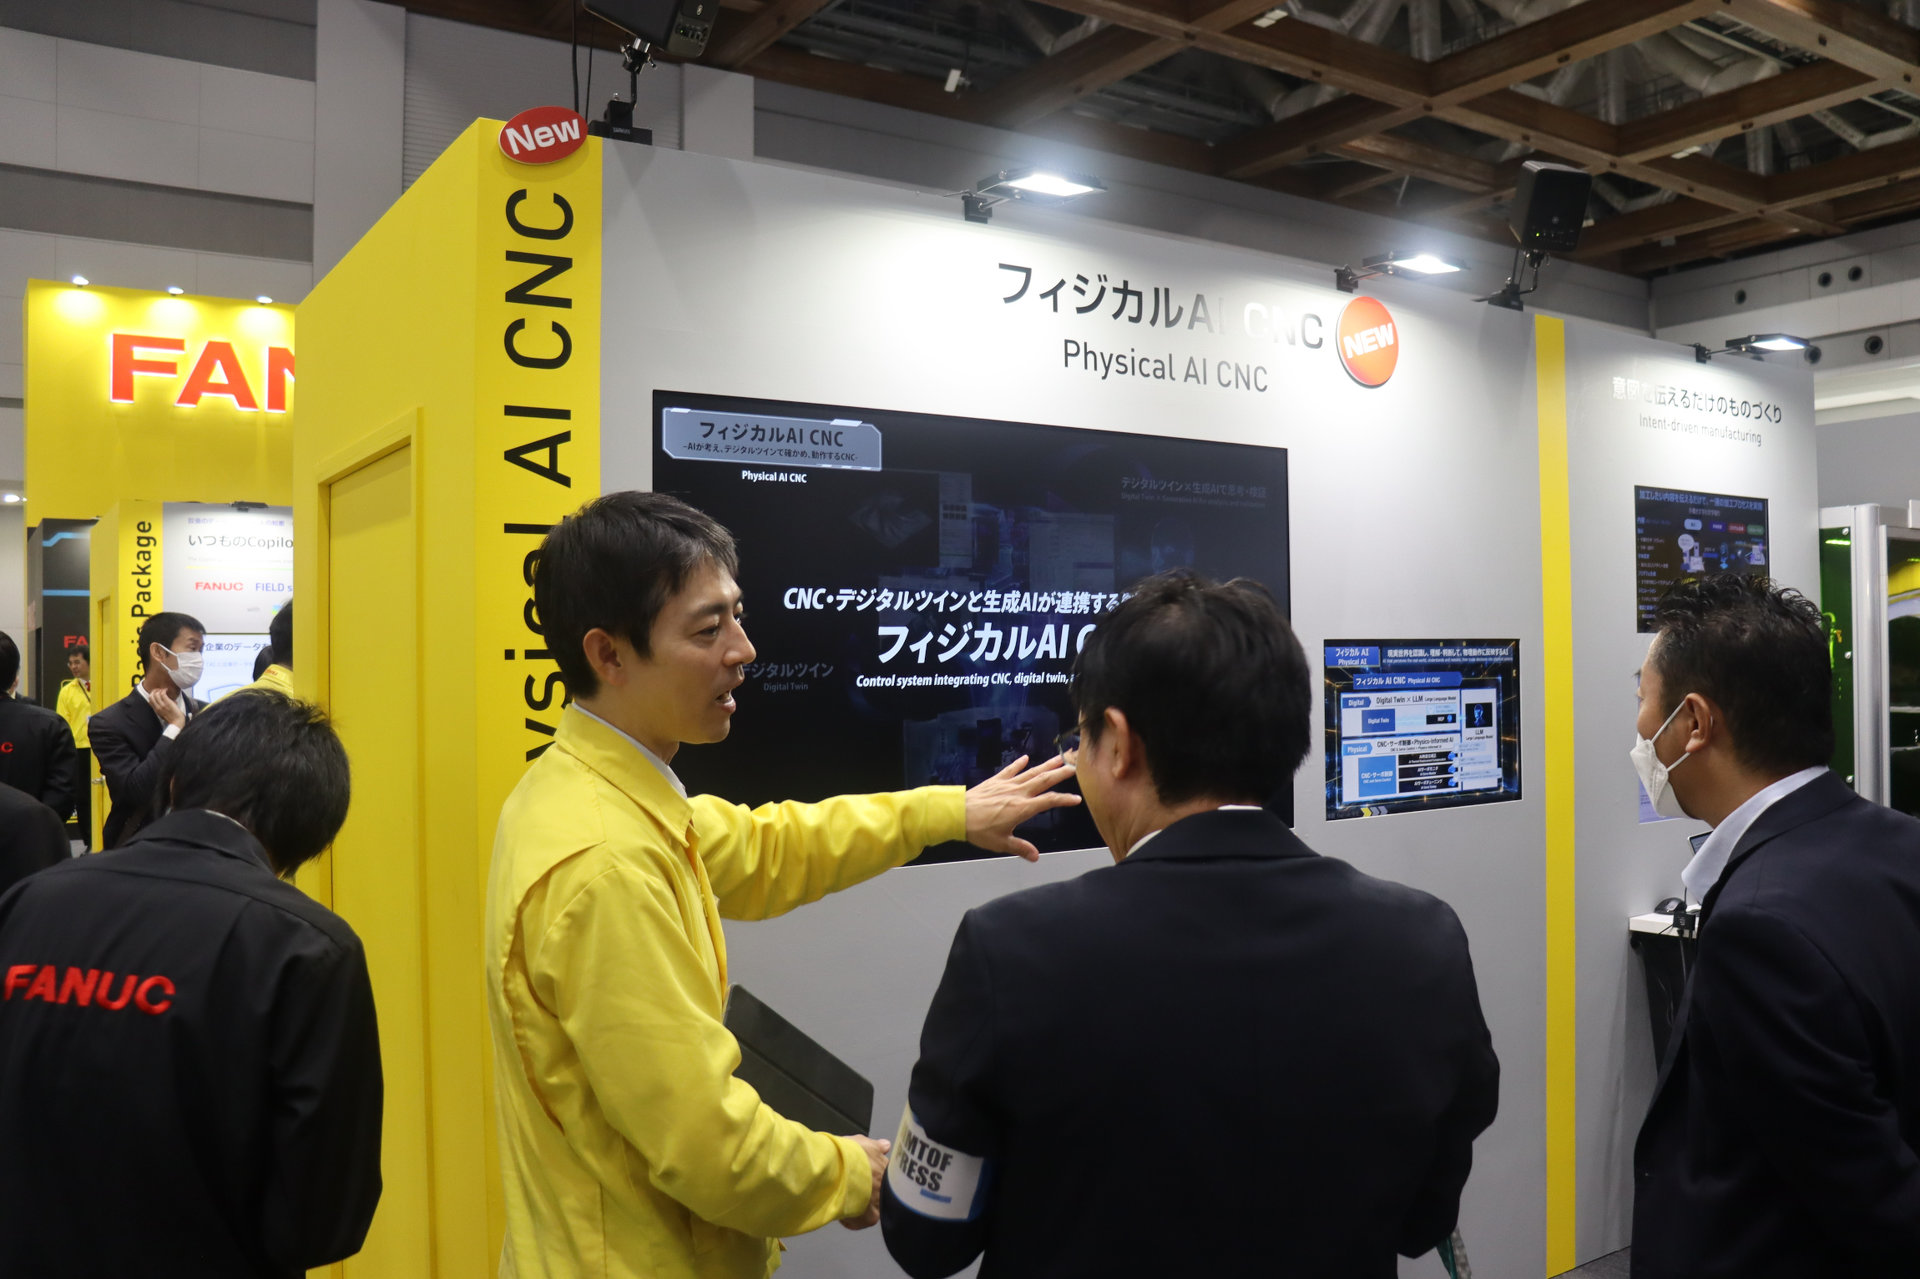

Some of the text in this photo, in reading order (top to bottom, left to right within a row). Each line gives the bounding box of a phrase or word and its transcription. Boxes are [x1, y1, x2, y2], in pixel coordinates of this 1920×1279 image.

[505, 118, 581, 156] New
[503, 188, 575, 371] CNC
[1343, 322, 1395, 359] NEW
[1064, 338, 1268, 392] Physical AI CNC
[700, 421, 844, 447] フィジカルAI CNC
[1639, 413, 1762, 447] Intent-driven manufacturing
[503, 405, 572, 489] AI
[741, 470, 808, 483] Physical AI CNC
[131, 521, 157, 617] Package
[195, 581, 244, 591] FANUC
[255, 582, 285, 592] FIELD
[783, 587, 1136, 614] CNC・デジタルツインと生成AIが連携する
[877, 621, 1069, 665] フィジカルAI
[1338, 659, 1360, 667] Physical
[763, 682, 809, 692] Digital Twin
[855, 674, 896, 687] Control
[896, 676, 933, 689] system
[933, 674, 990, 688] integrating
[990, 672, 1013, 685] CNC,
[1013, 672, 1045, 686] digital
[1045, 672, 1070, 685] twin,
[1392, 676, 1406, 684] CNC
[1376, 696, 1392, 705] Digital
[3, 964, 177, 1016] FANUC
